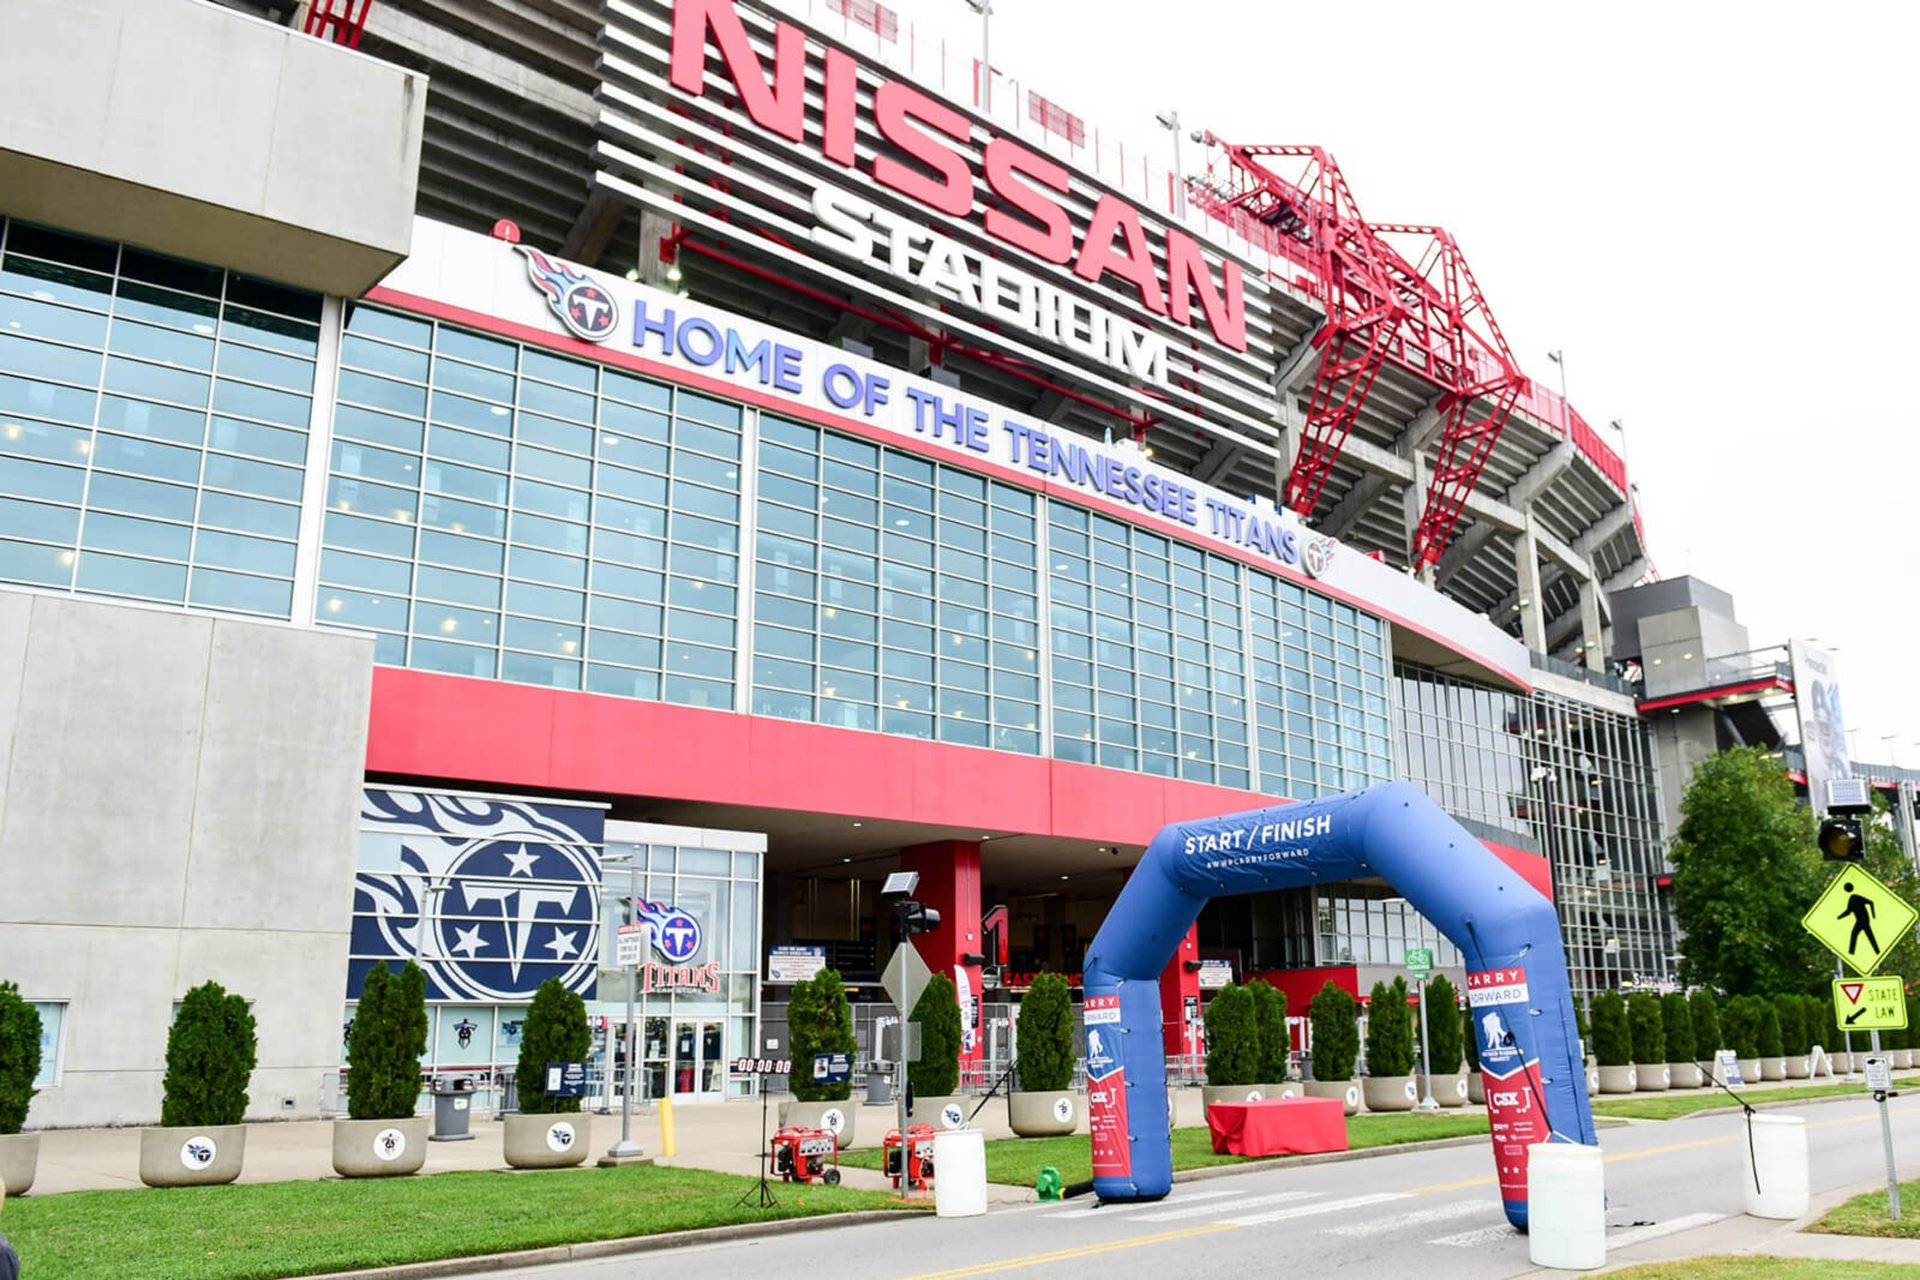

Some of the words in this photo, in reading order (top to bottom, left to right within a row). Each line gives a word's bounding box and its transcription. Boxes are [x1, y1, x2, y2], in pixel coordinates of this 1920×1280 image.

[670, 0, 1248, 353] NISSAN
[810, 185, 1170, 385] STADIUM
[633, 299, 803, 394] HOME
[823, 363, 891, 416] OF
[906, 386, 990, 453] THE
[1003, 419, 1198, 526] TENNESSEE
[1204, 497, 1299, 565] TITANS
[1184, 829, 1245, 855] START
[1261, 814, 1332, 845] FINISH
[984, 907, 1009, 966] 1
[640, 961, 720, 994] TITANS
[1868, 988, 1898, 1002] STATE
[1875, 1006, 1896, 1019] LAW
[1493, 1092, 1520, 1106] CSX
